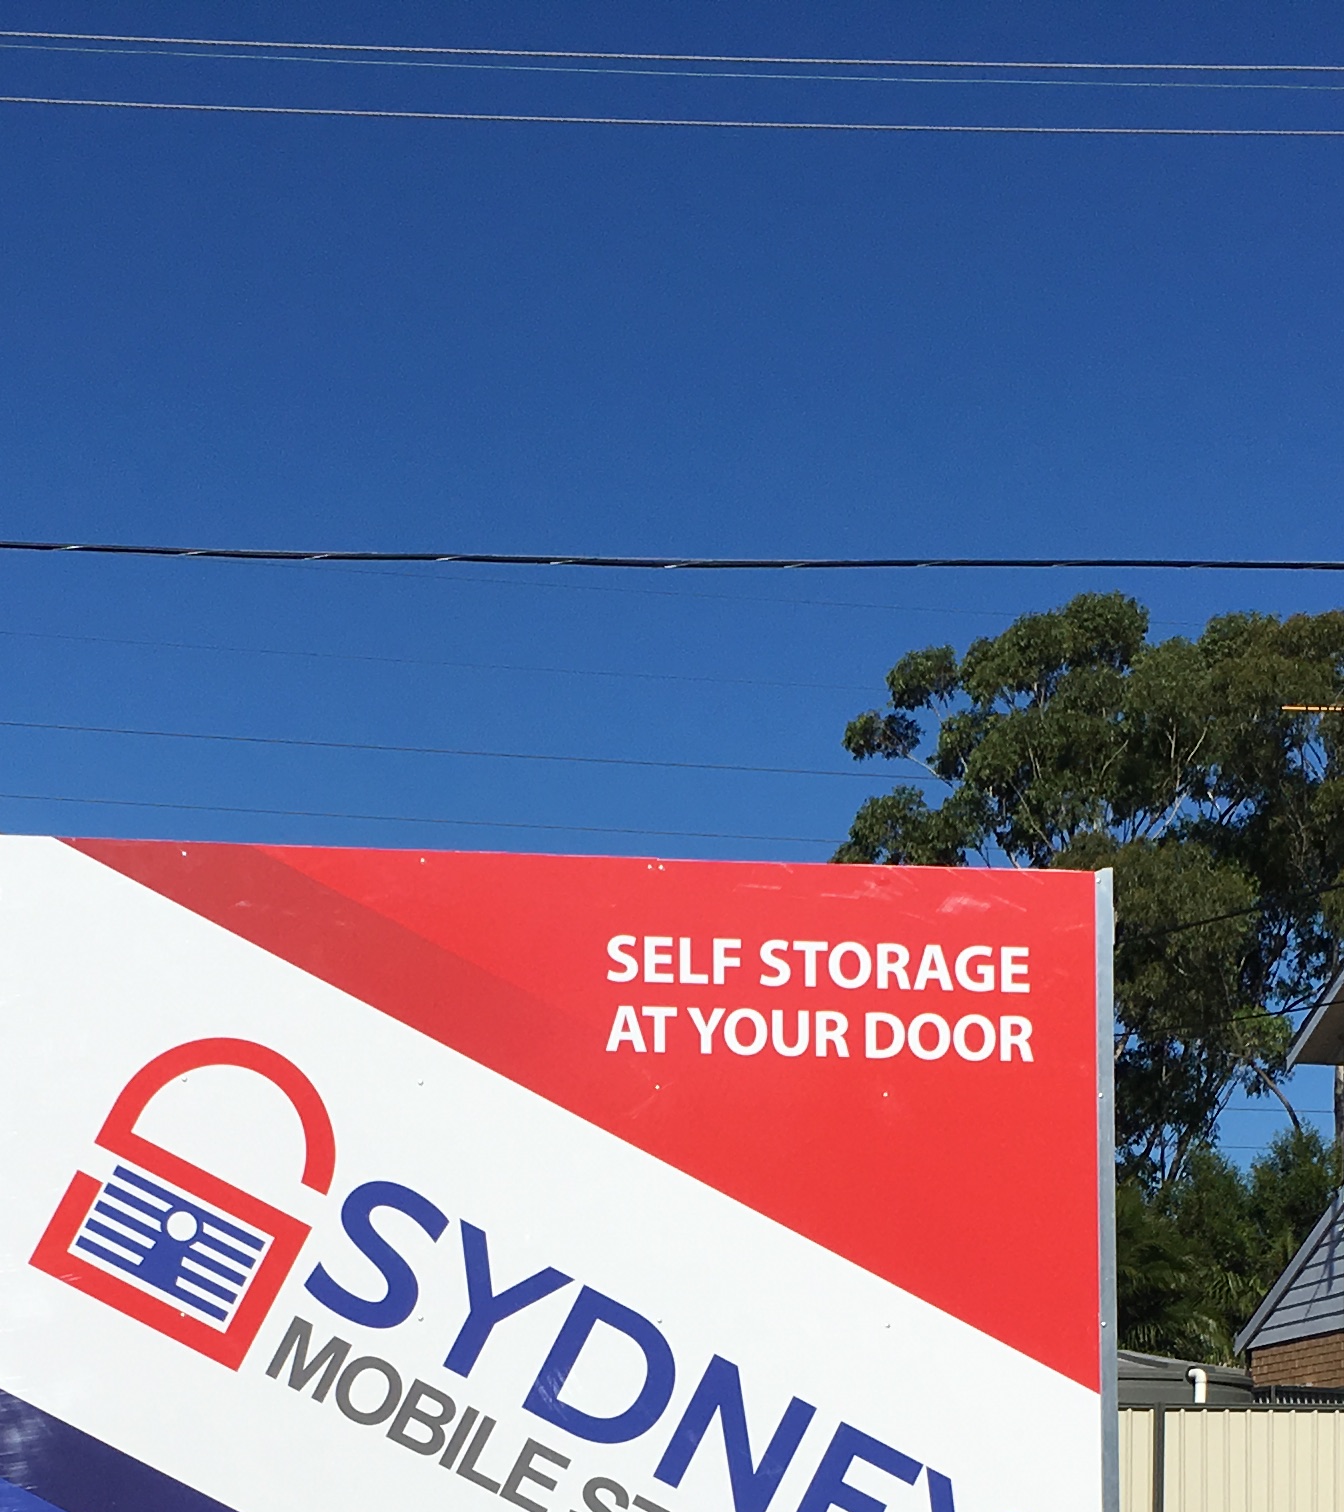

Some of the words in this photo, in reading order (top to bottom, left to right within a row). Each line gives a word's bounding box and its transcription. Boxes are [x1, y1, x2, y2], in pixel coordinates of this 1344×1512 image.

[605, 933, 743, 986] SELF
[758, 938, 1031, 994] STORAGE
[604, 1004, 679, 1054] AT
[685, 1006, 851, 1059] YOUR
[864, 1010, 1035, 1063] DOOR
